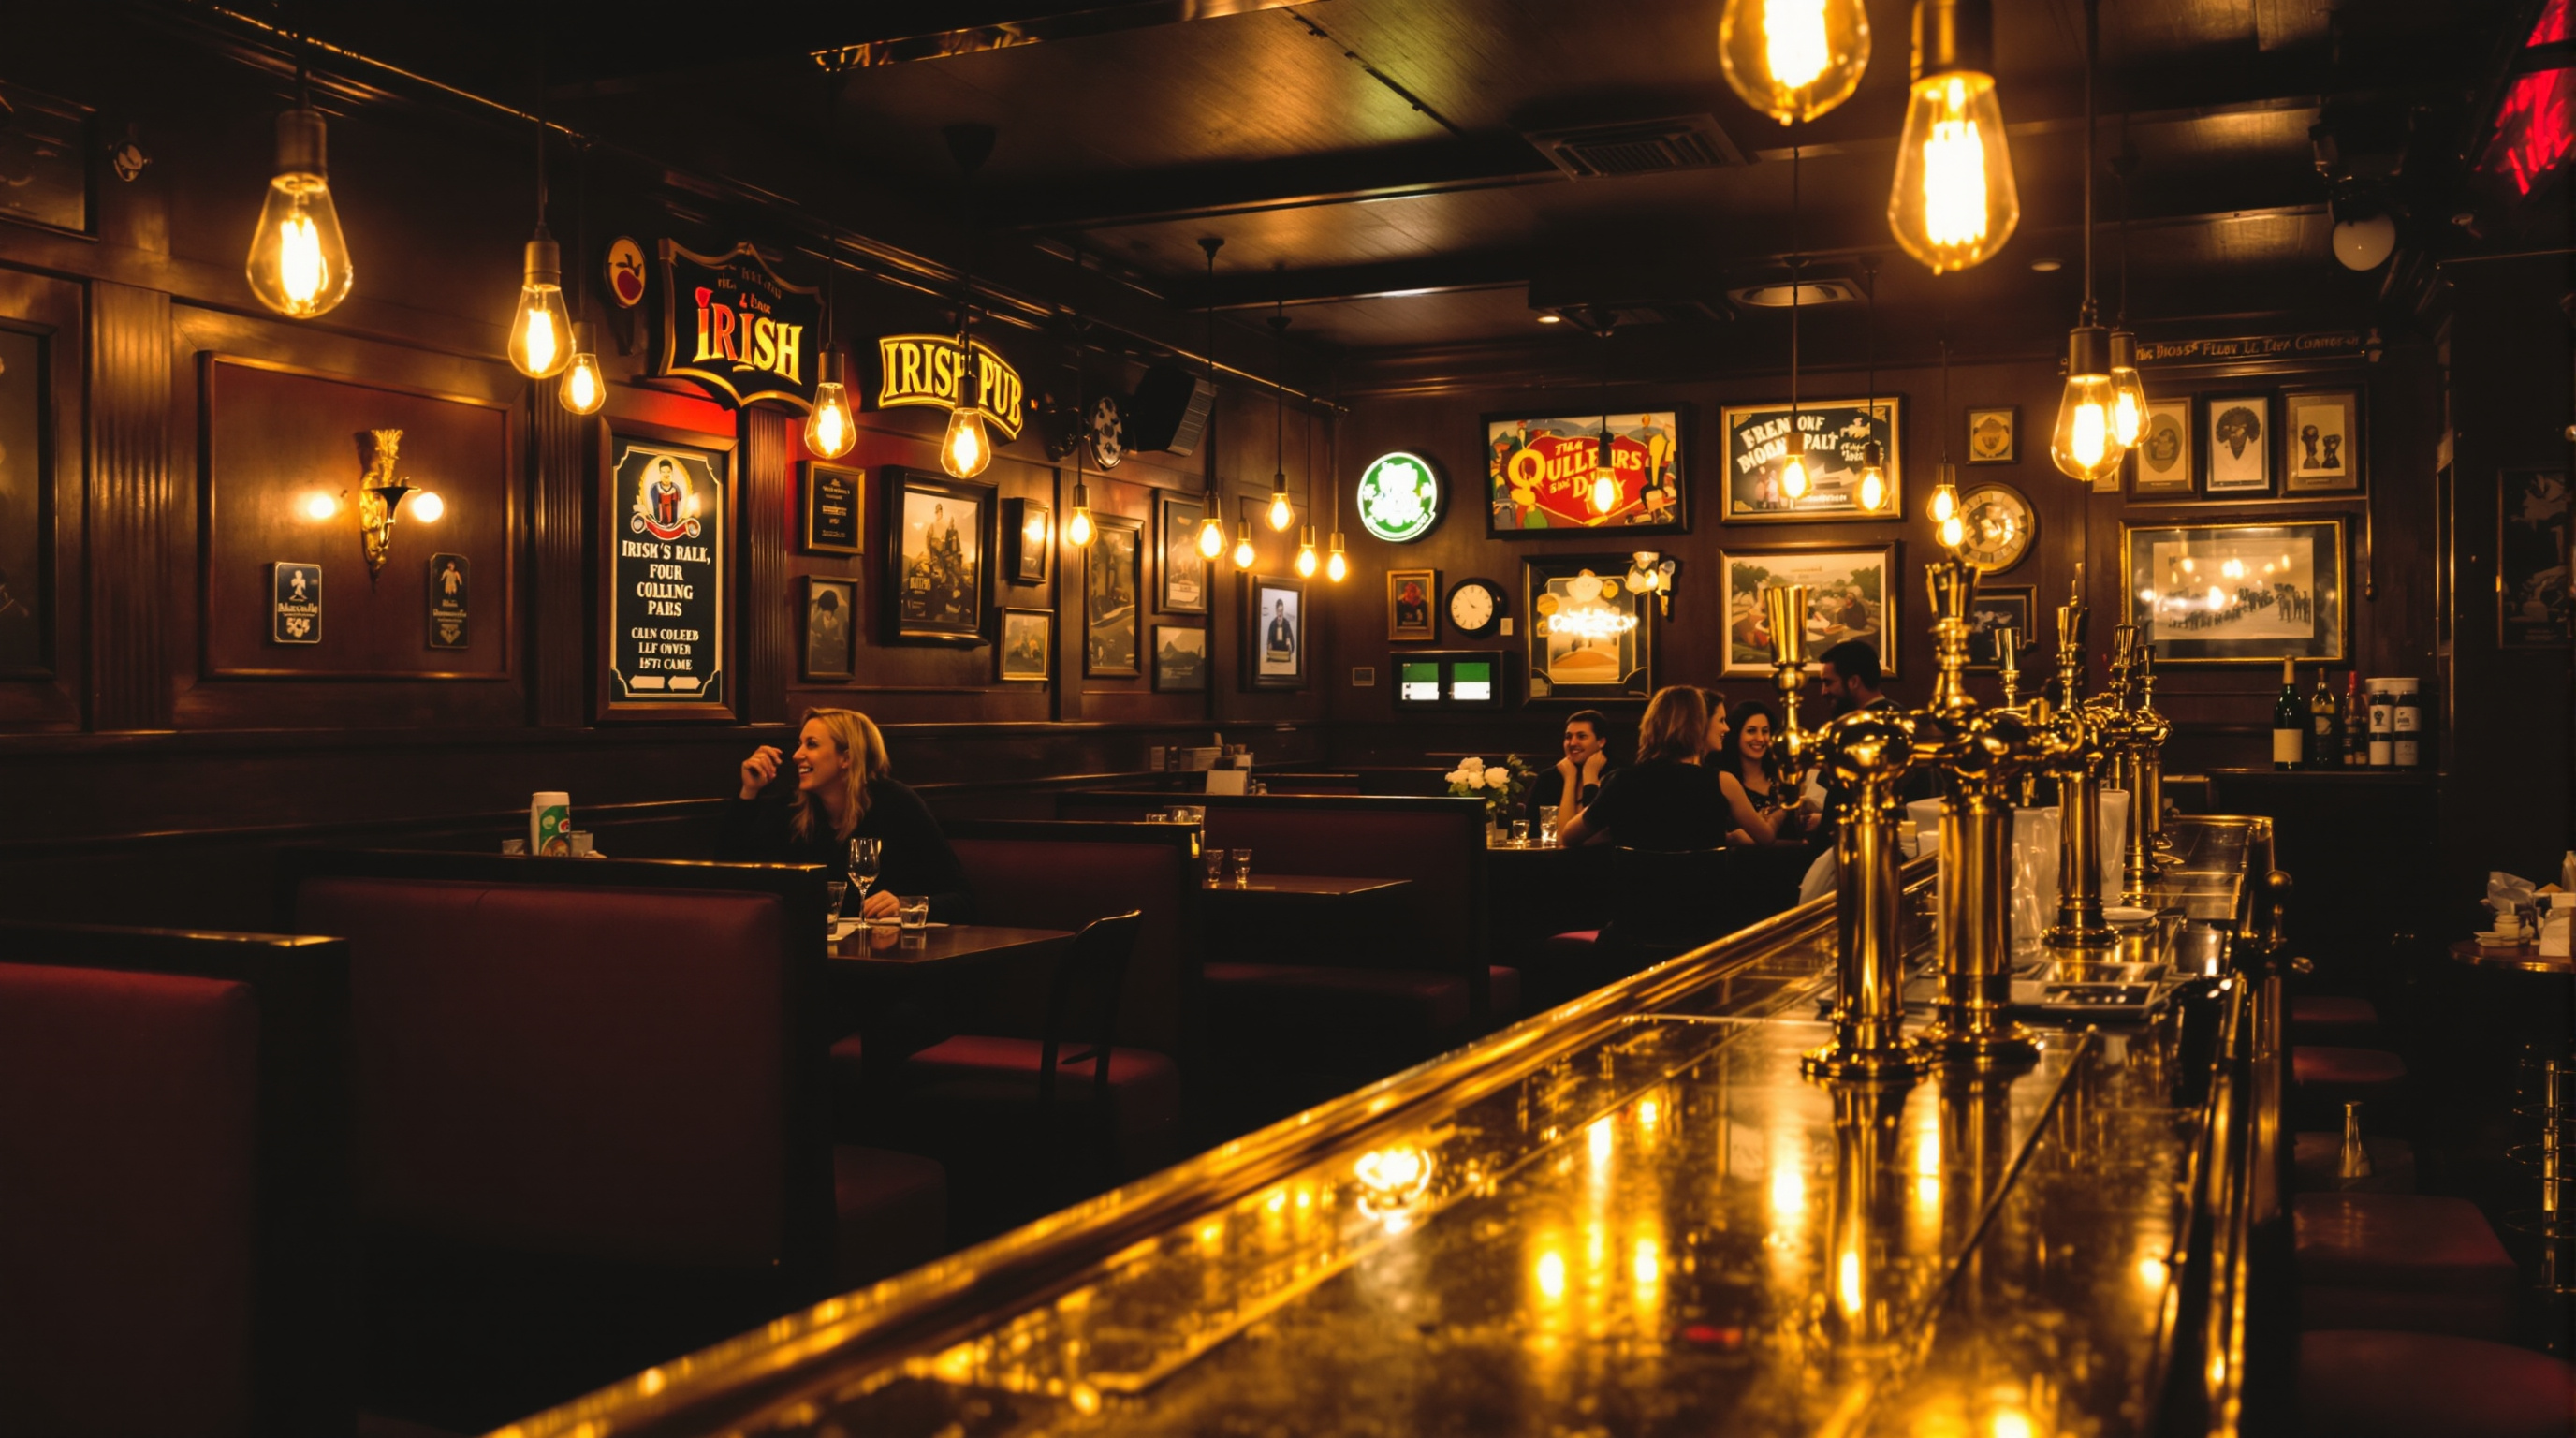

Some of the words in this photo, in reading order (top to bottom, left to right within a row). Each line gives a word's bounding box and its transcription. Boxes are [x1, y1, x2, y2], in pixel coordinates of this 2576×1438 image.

[978, 353, 1022, 427] PUB
[650, 564, 684, 580] FOUR
[637, 581, 694, 600] COLLING
[664, 658, 693, 670] CAME
